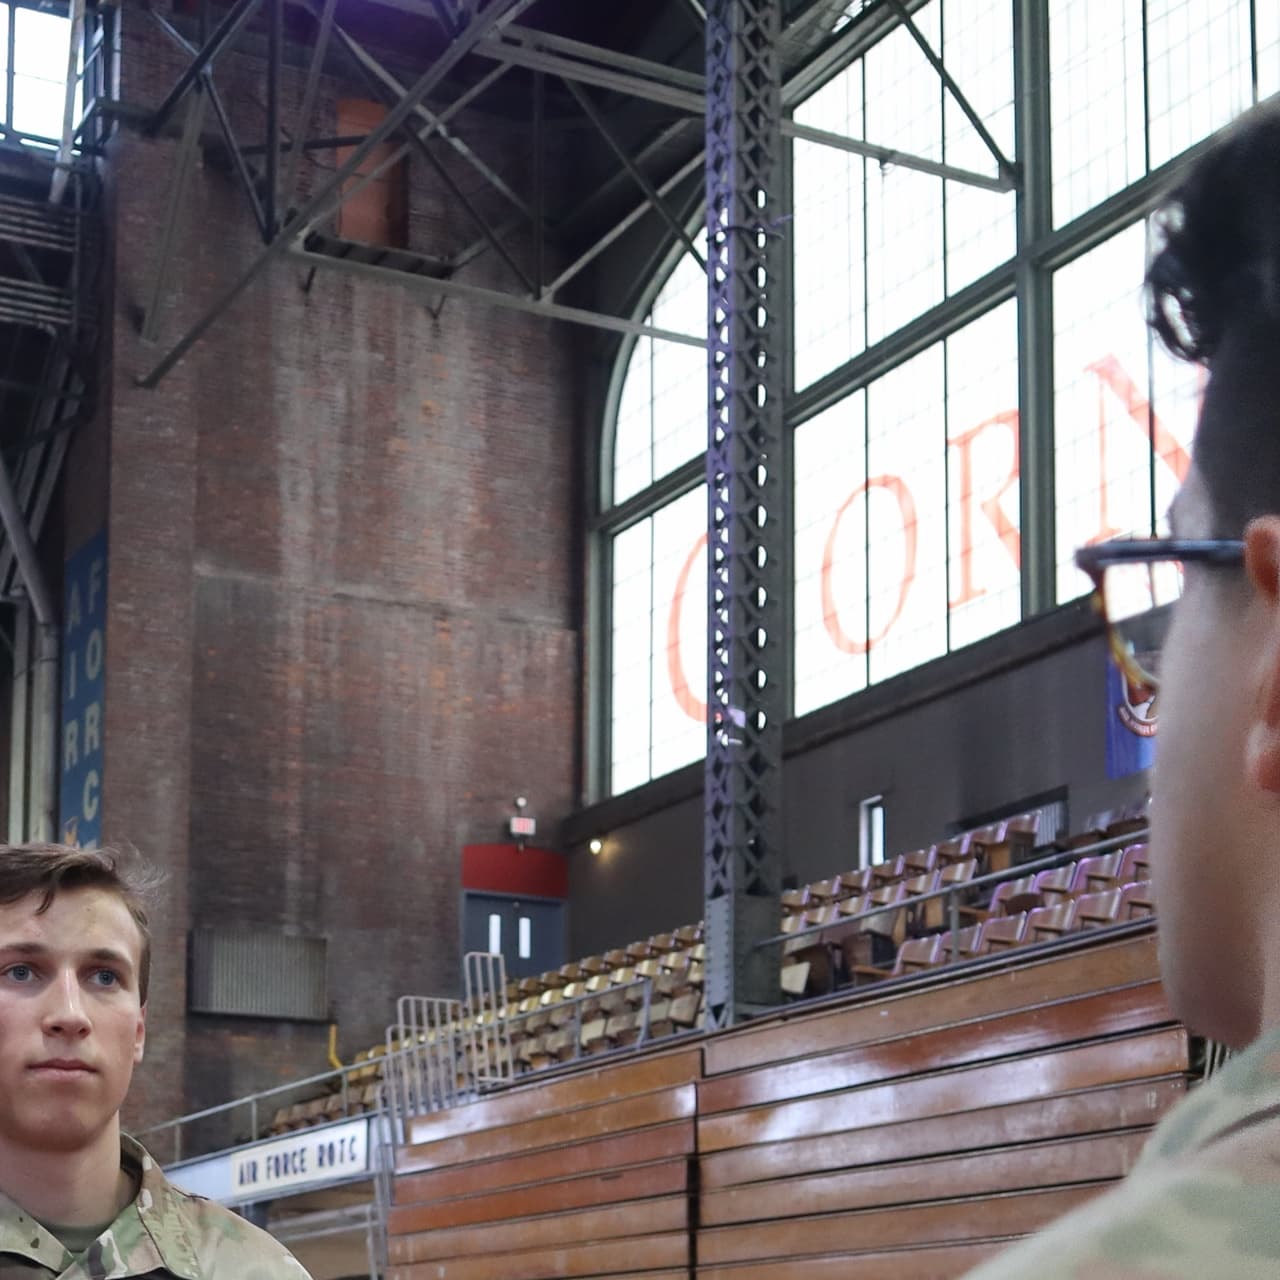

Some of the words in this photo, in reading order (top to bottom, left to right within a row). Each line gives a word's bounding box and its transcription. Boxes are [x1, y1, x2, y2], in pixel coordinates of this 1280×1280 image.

[65, 578, 81, 773] AIR
[82, 557, 102, 852] FORC
[239, 1160, 259, 1185] AIR
[267, 1147, 307, 1180] FORCE
[317, 1135, 357, 1168] ROTC
